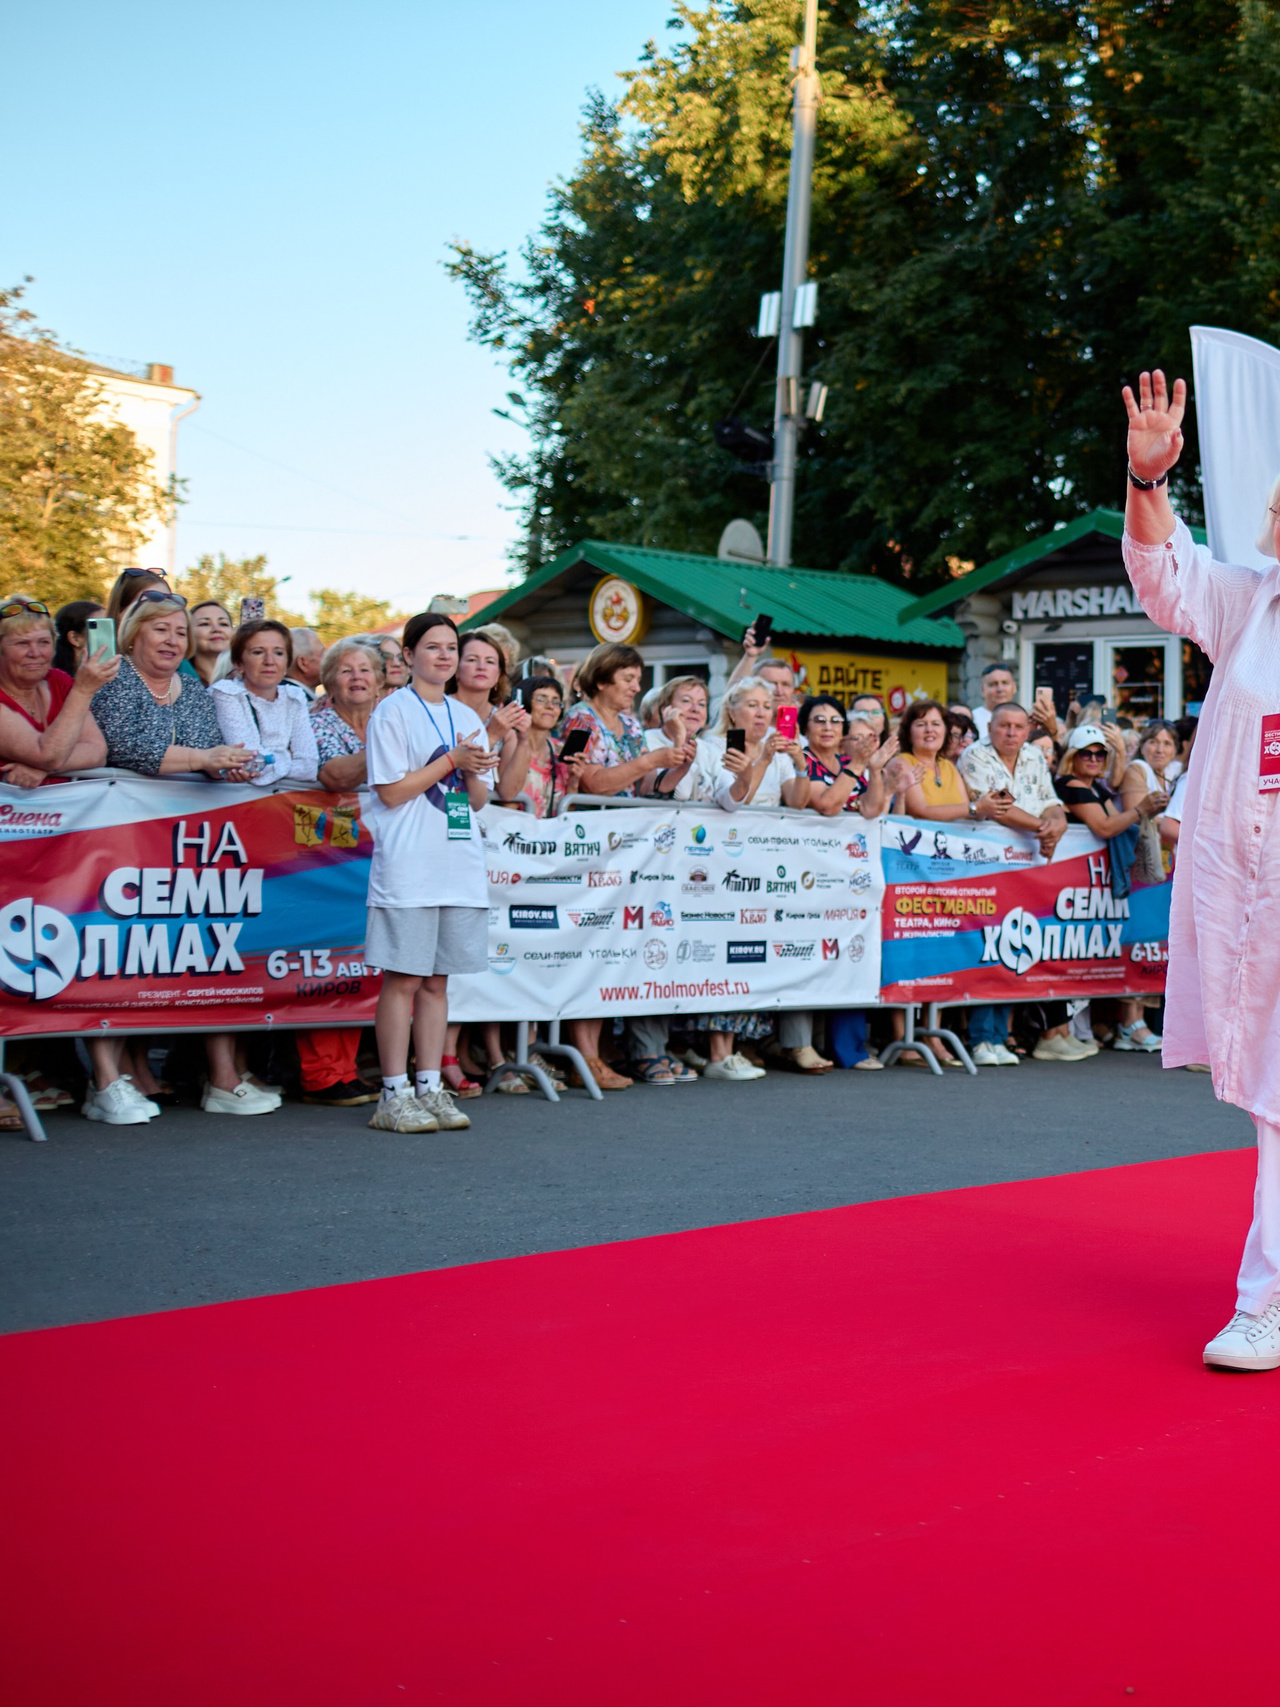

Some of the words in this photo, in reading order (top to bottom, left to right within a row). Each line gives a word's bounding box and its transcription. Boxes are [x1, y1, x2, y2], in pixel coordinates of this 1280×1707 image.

[819, 663, 882, 689] ДАЙТЕ
[175, 821, 249, 864] НА
[564, 841, 600, 856] ВЯТИЧ
[102, 867, 265, 916] СЕМИ
[766, 880, 797, 893] ВЯТИЧ
[895, 886, 926, 895] ВТОРОЙ
[895, 896, 997, 916] ФЕСТИВАЛЬ
[1055, 886, 1131, 920] СЕМИ
[512, 910, 554, 920] KIROV.RU
[823, 909, 859, 920] МАРИЯ
[894, 917, 932, 928] ТЕАТРА,
[933, 917, 960, 928] КИНО
[982, 906, 1123, 974] ХОЛМАХ
[730, 945, 765, 955] KIROV.RU
[1130, 942, 1161, 962] 6-13
[266, 949, 333, 979] 6-13
[138, 991, 181, 999] ПРЕЗИДЕНТ
[187, 988, 215, 997] СЕРГЕЙ
[216, 987, 264, 996] НОВОЖИЛОВ
[296, 981, 362, 997] КИРОВ
[599, 979, 750, 1001] www.7holmovfest.ru
